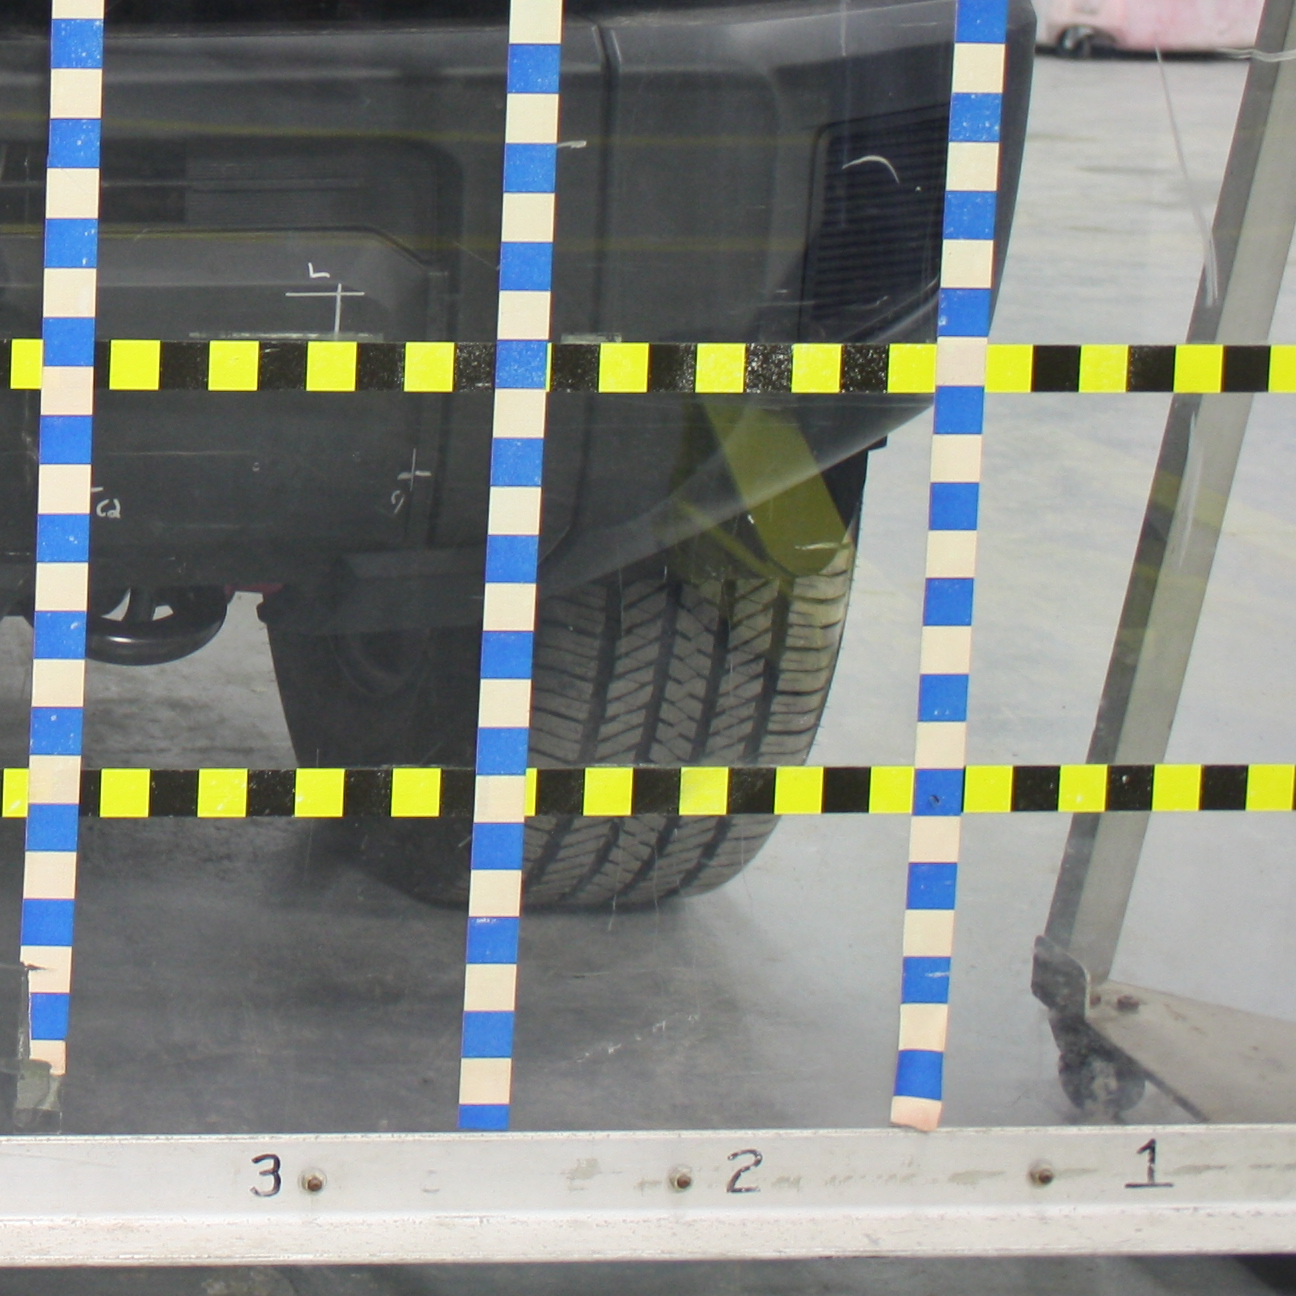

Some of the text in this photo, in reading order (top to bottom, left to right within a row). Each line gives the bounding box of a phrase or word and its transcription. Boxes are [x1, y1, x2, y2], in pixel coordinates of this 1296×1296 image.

[250, 1153, 282, 1197] 3
[727, 1149, 763, 1193] 2
[1125, 1139, 1174, 1189] 1
